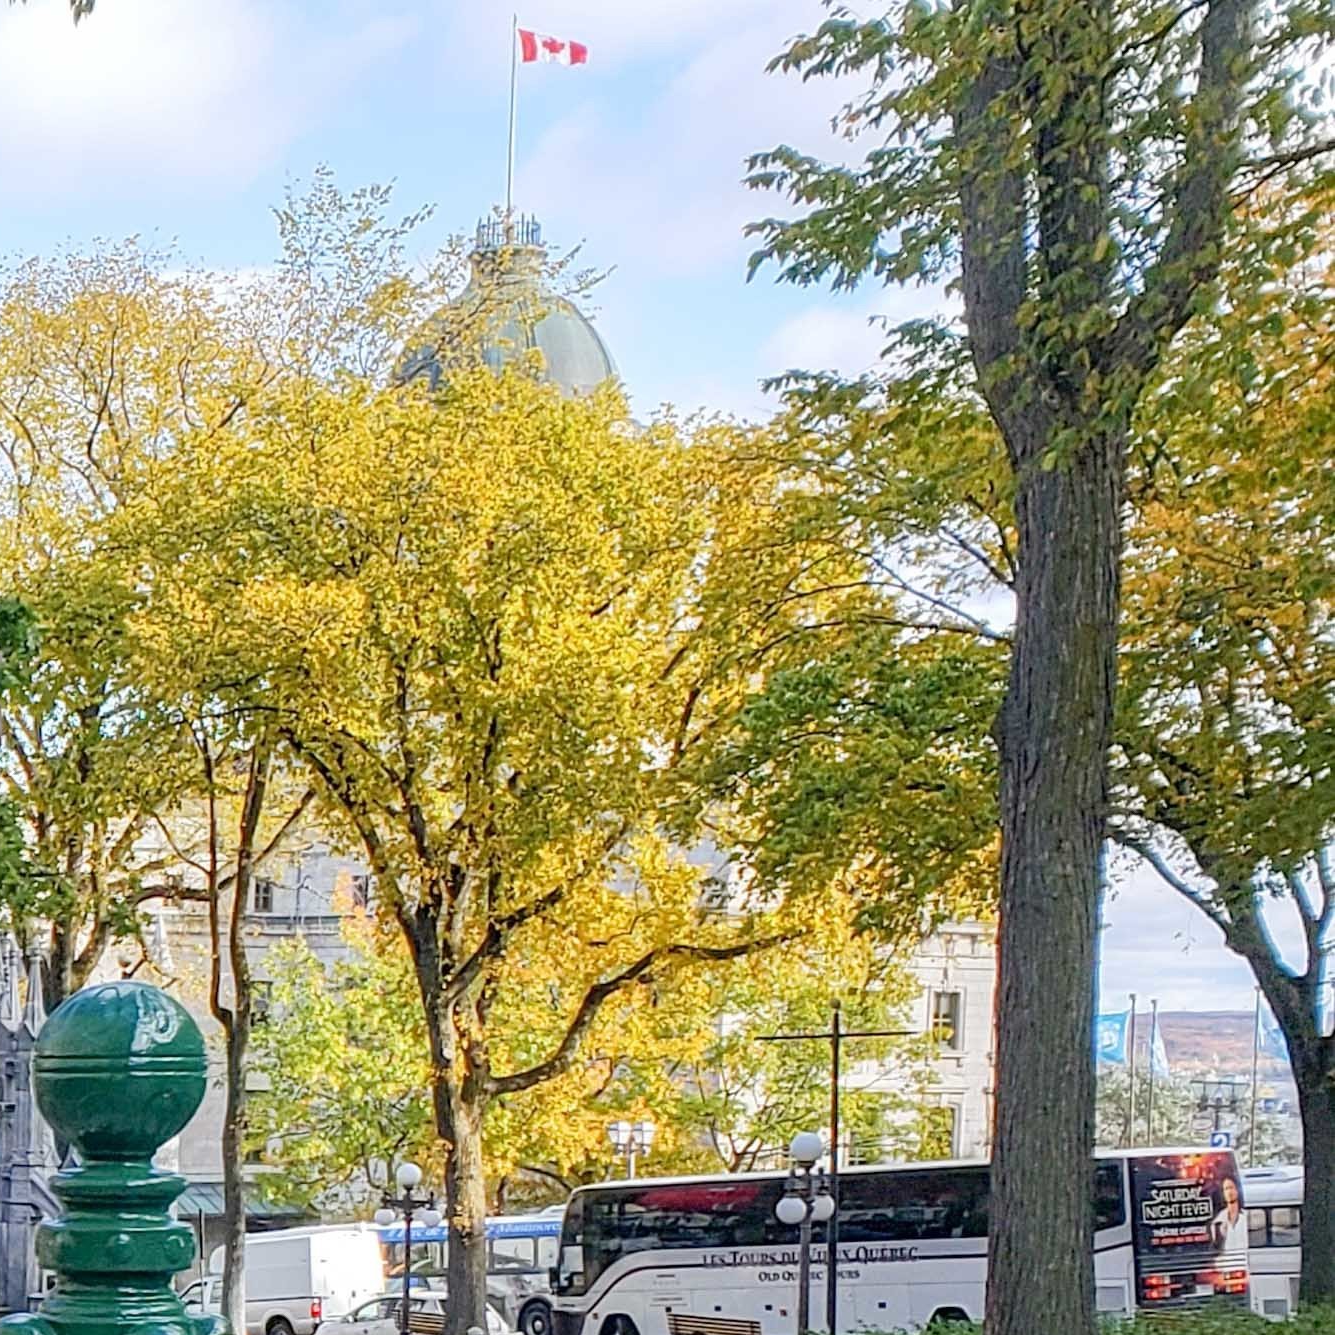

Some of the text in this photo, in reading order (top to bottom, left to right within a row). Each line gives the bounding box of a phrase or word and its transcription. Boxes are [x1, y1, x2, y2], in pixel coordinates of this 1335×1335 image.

[1150, 1186, 1203, 1203] SATURDAY
[1145, 1202, 1210, 1218] NIGHT FEVER
[728, 1251, 777, 1265] TOURS
[758, 1271, 780, 1282] OLD
[782, 1270, 824, 1282] QUEC
